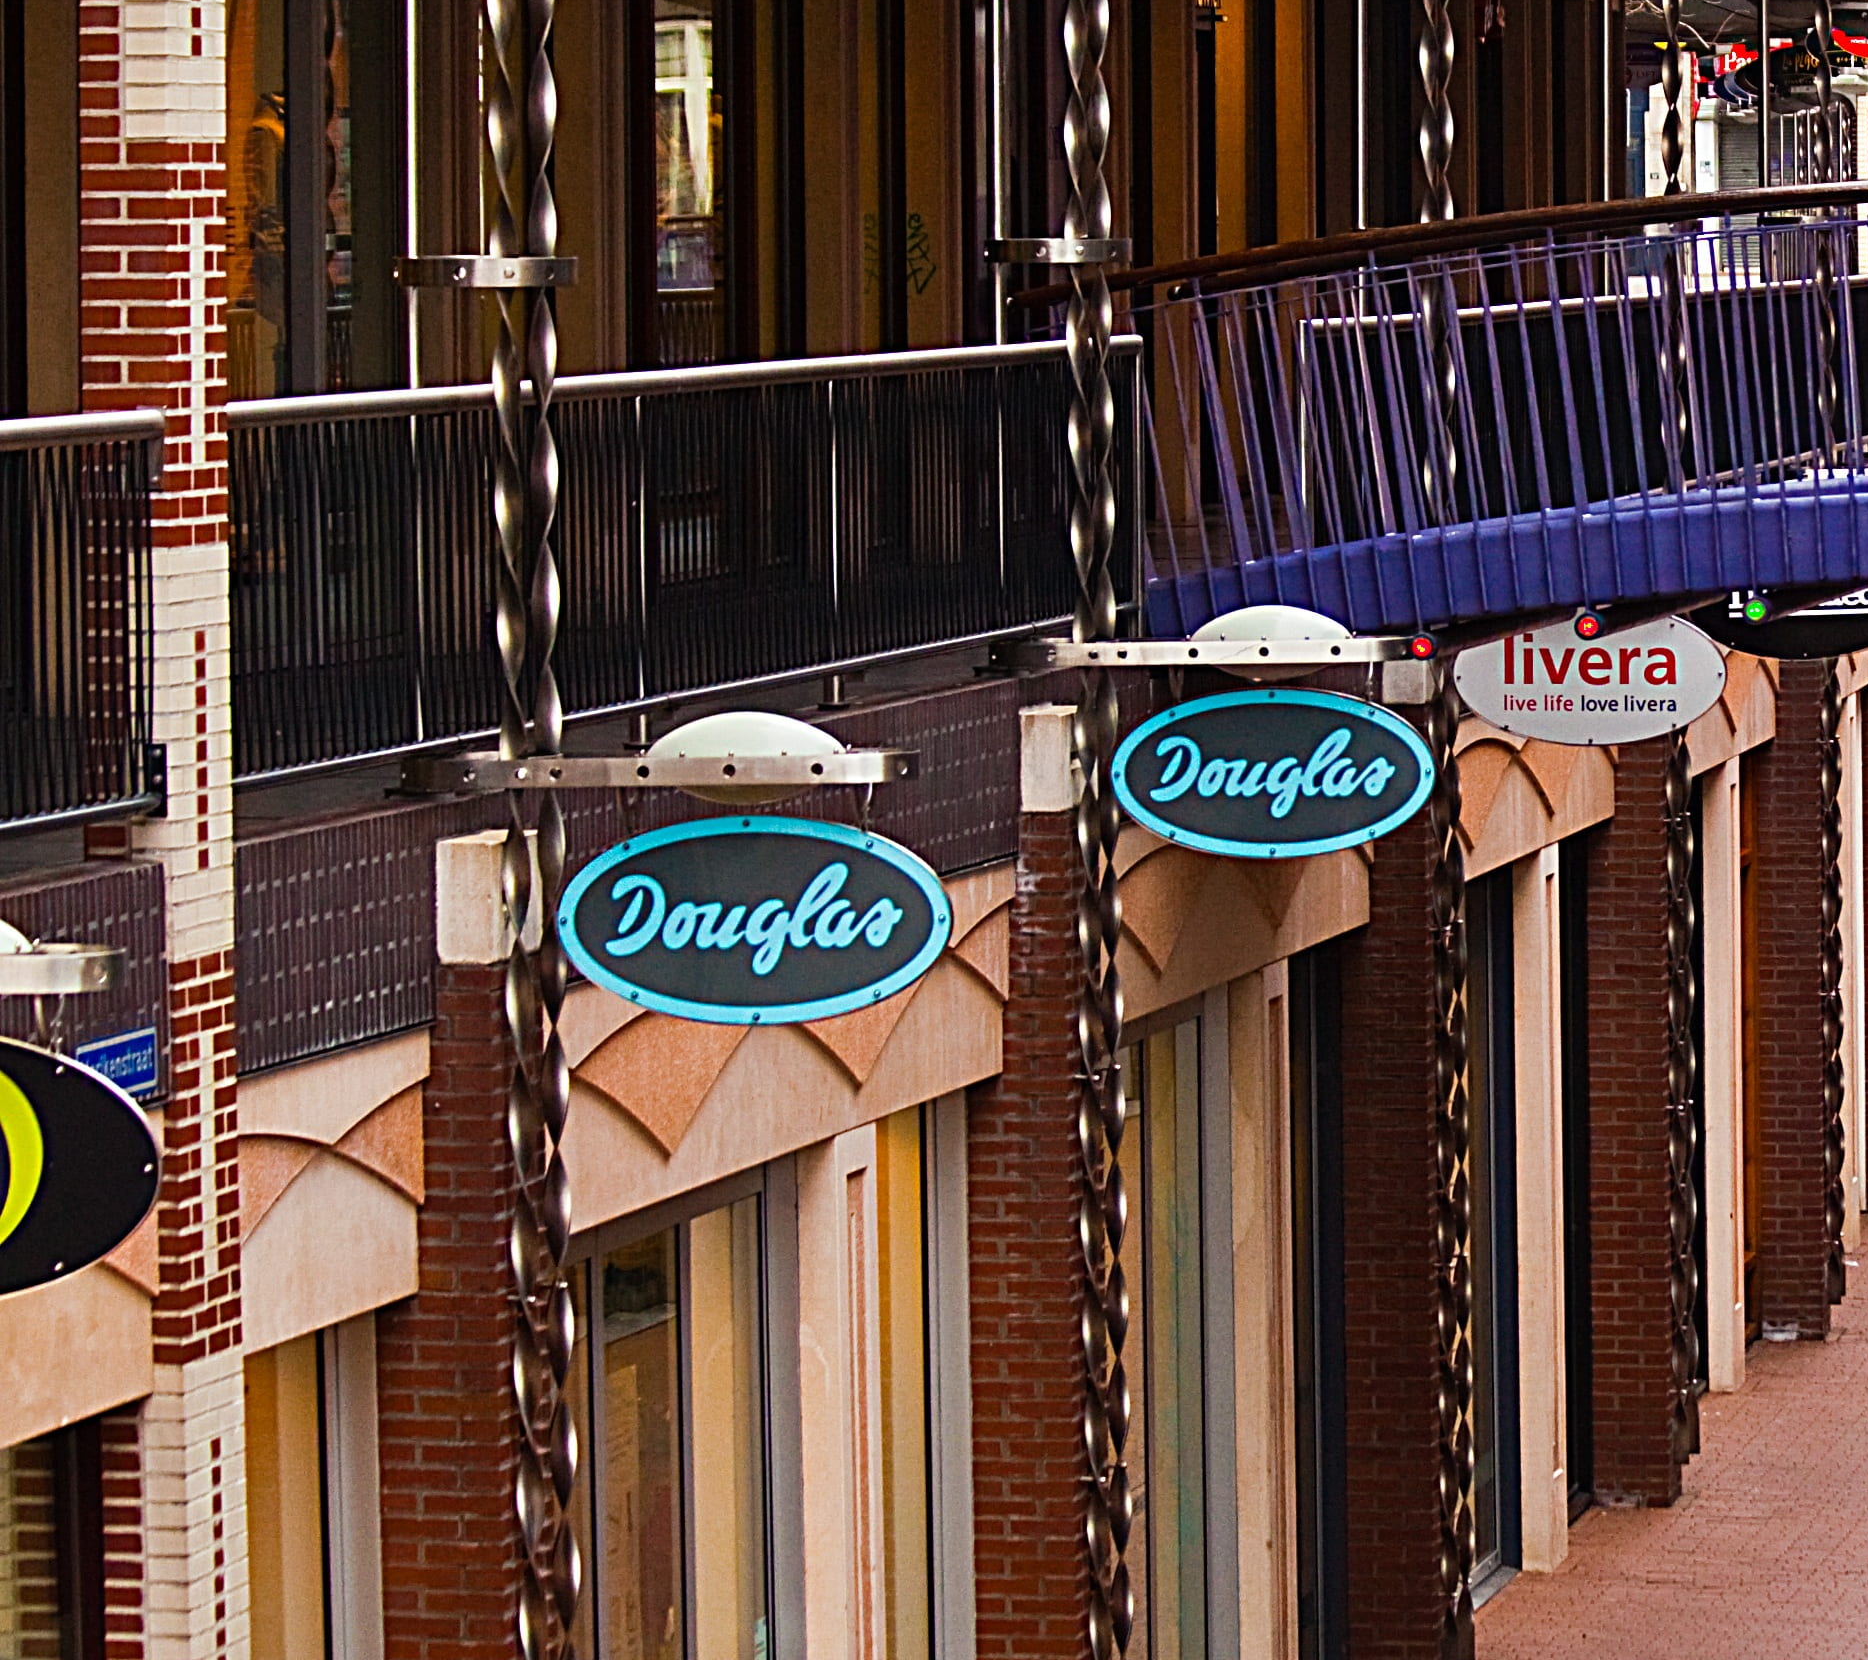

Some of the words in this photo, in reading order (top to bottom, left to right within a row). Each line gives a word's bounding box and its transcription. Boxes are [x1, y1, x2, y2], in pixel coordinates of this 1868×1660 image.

[1504, 633, 1677, 686] livera
[1503, 694, 1537, 712] live
[1544, 694, 1574, 712] life
[1581, 694, 1619, 712] love
[1624, 694, 1677, 712] livera
[1149, 727, 1396, 820] Douglas
[604, 860, 903, 977] Douglas
